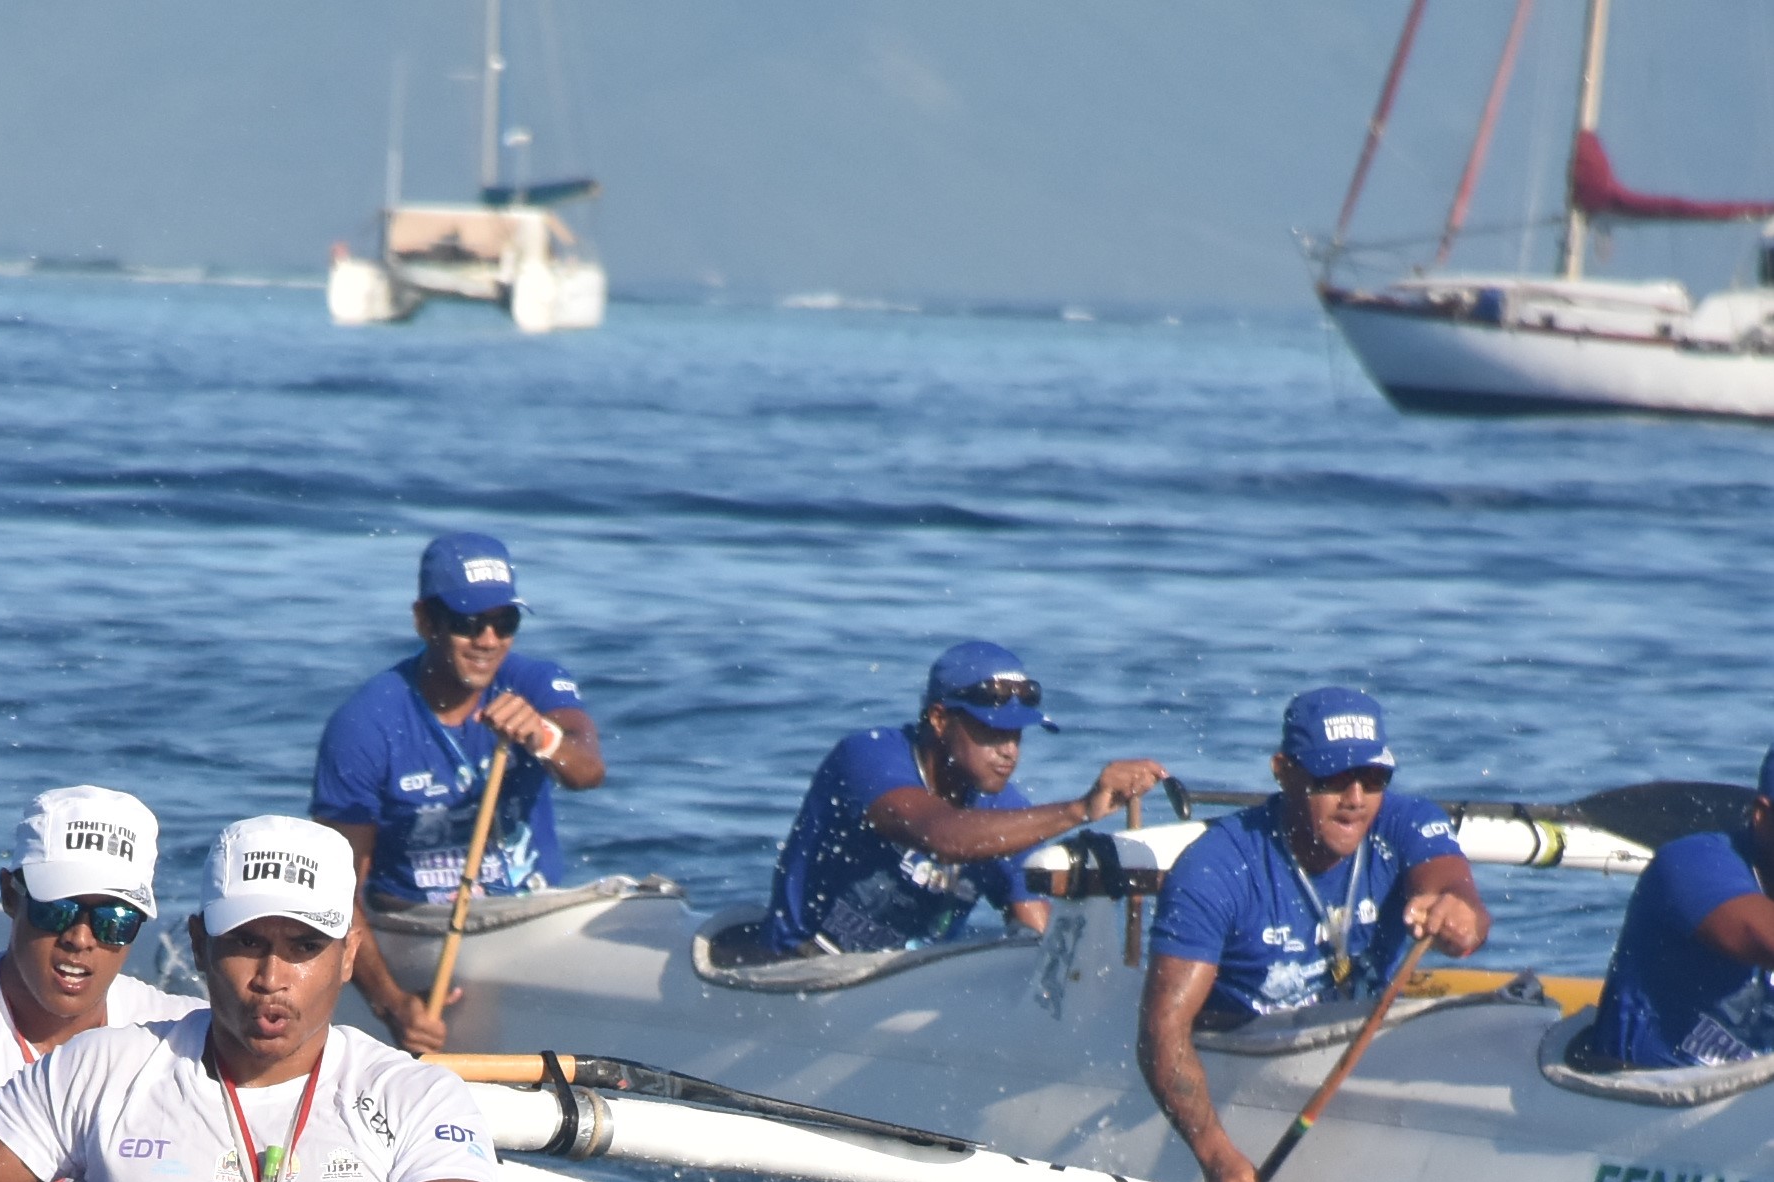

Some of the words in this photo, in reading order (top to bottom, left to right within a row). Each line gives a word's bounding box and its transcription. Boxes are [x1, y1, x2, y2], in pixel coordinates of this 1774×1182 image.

[66, 820, 113, 833] TAHITI
[118, 826, 137, 844] NUI
[242, 850, 291, 863] TAHITI
[295, 854, 319, 872] NUI
[434, 1123, 477, 1143] EDT
[118, 1137, 172, 1161] EDT
[327, 1162, 360, 1173] IJSPF
